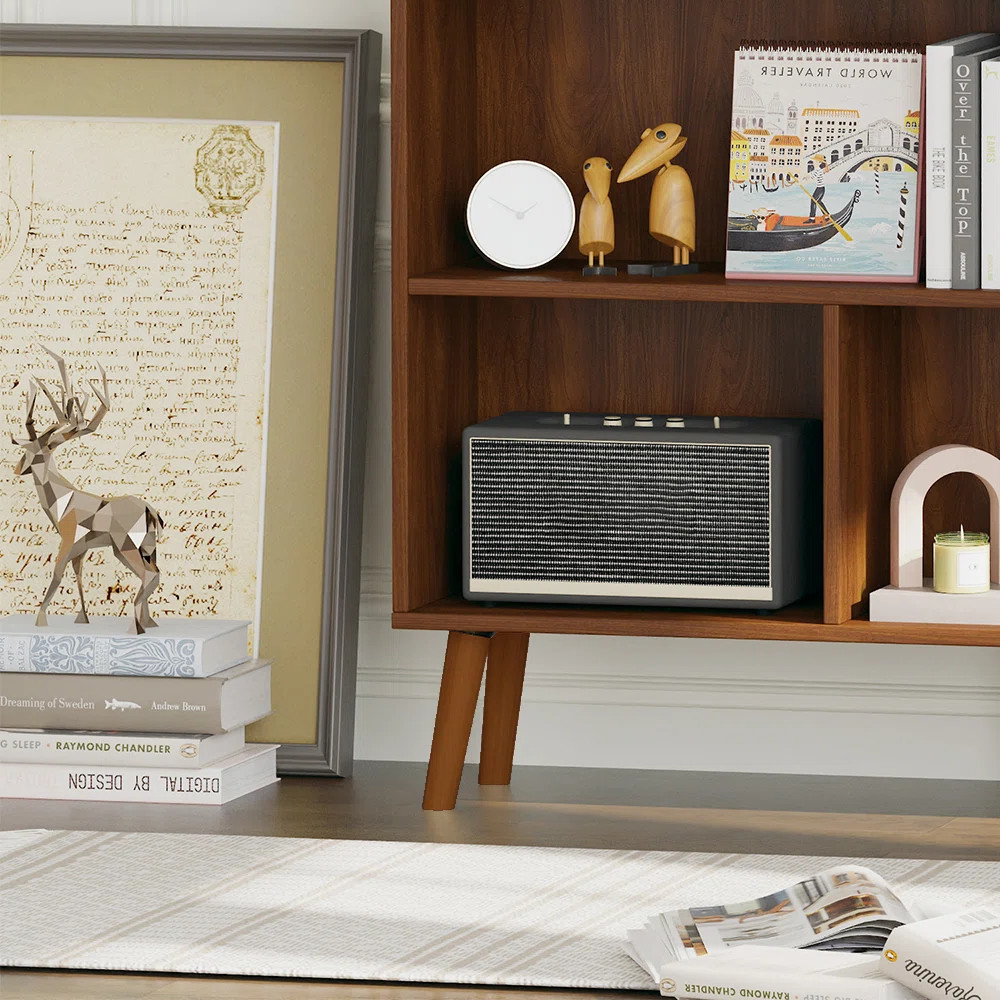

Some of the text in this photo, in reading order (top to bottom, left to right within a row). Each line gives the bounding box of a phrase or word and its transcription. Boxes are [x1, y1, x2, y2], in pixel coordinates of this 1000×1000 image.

[956, 64, 970, 234] Over the Top
[0, 696, 206, 712] Dreaming of Sweden Andrew Brown
[12, 740, 41, 749] SLEEP
[56, 741, 111, 752] RAYMOND
[114, 743, 171, 754] CHANDLER
[68, 773, 123, 791] DESIGN
[133, 775, 150, 791] BY
[160, 776, 220, 794] DIGITAL
[684, 983, 736, 997] CHANDLER
[739, 989, 790, 1000] RAYMOND
